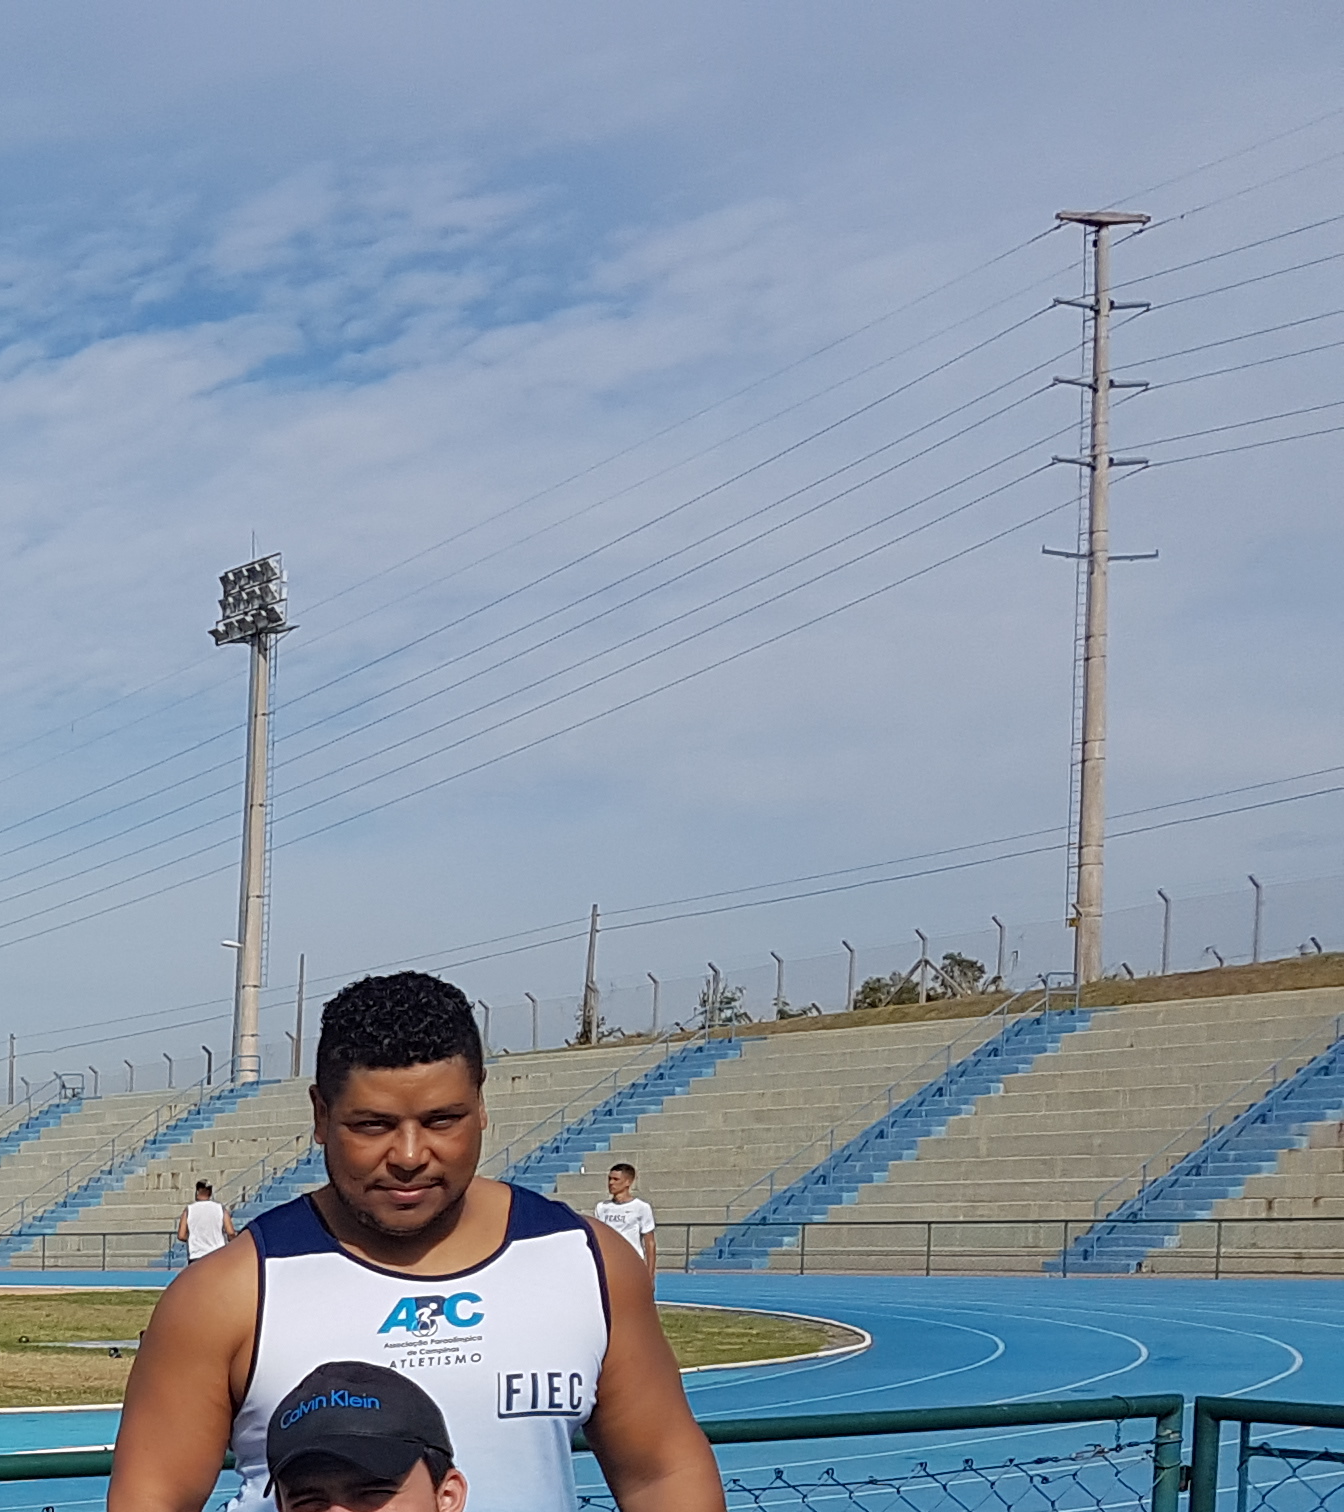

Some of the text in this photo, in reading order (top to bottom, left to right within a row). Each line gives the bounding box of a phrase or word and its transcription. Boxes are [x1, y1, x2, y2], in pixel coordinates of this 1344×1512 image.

[377, 1292, 485, 1334] APC
[389, 1353, 482, 1369] ATLETISMO
[280, 1389, 381, 1429] Calvin Klein
[506, 1372, 583, 1411] FIEC
